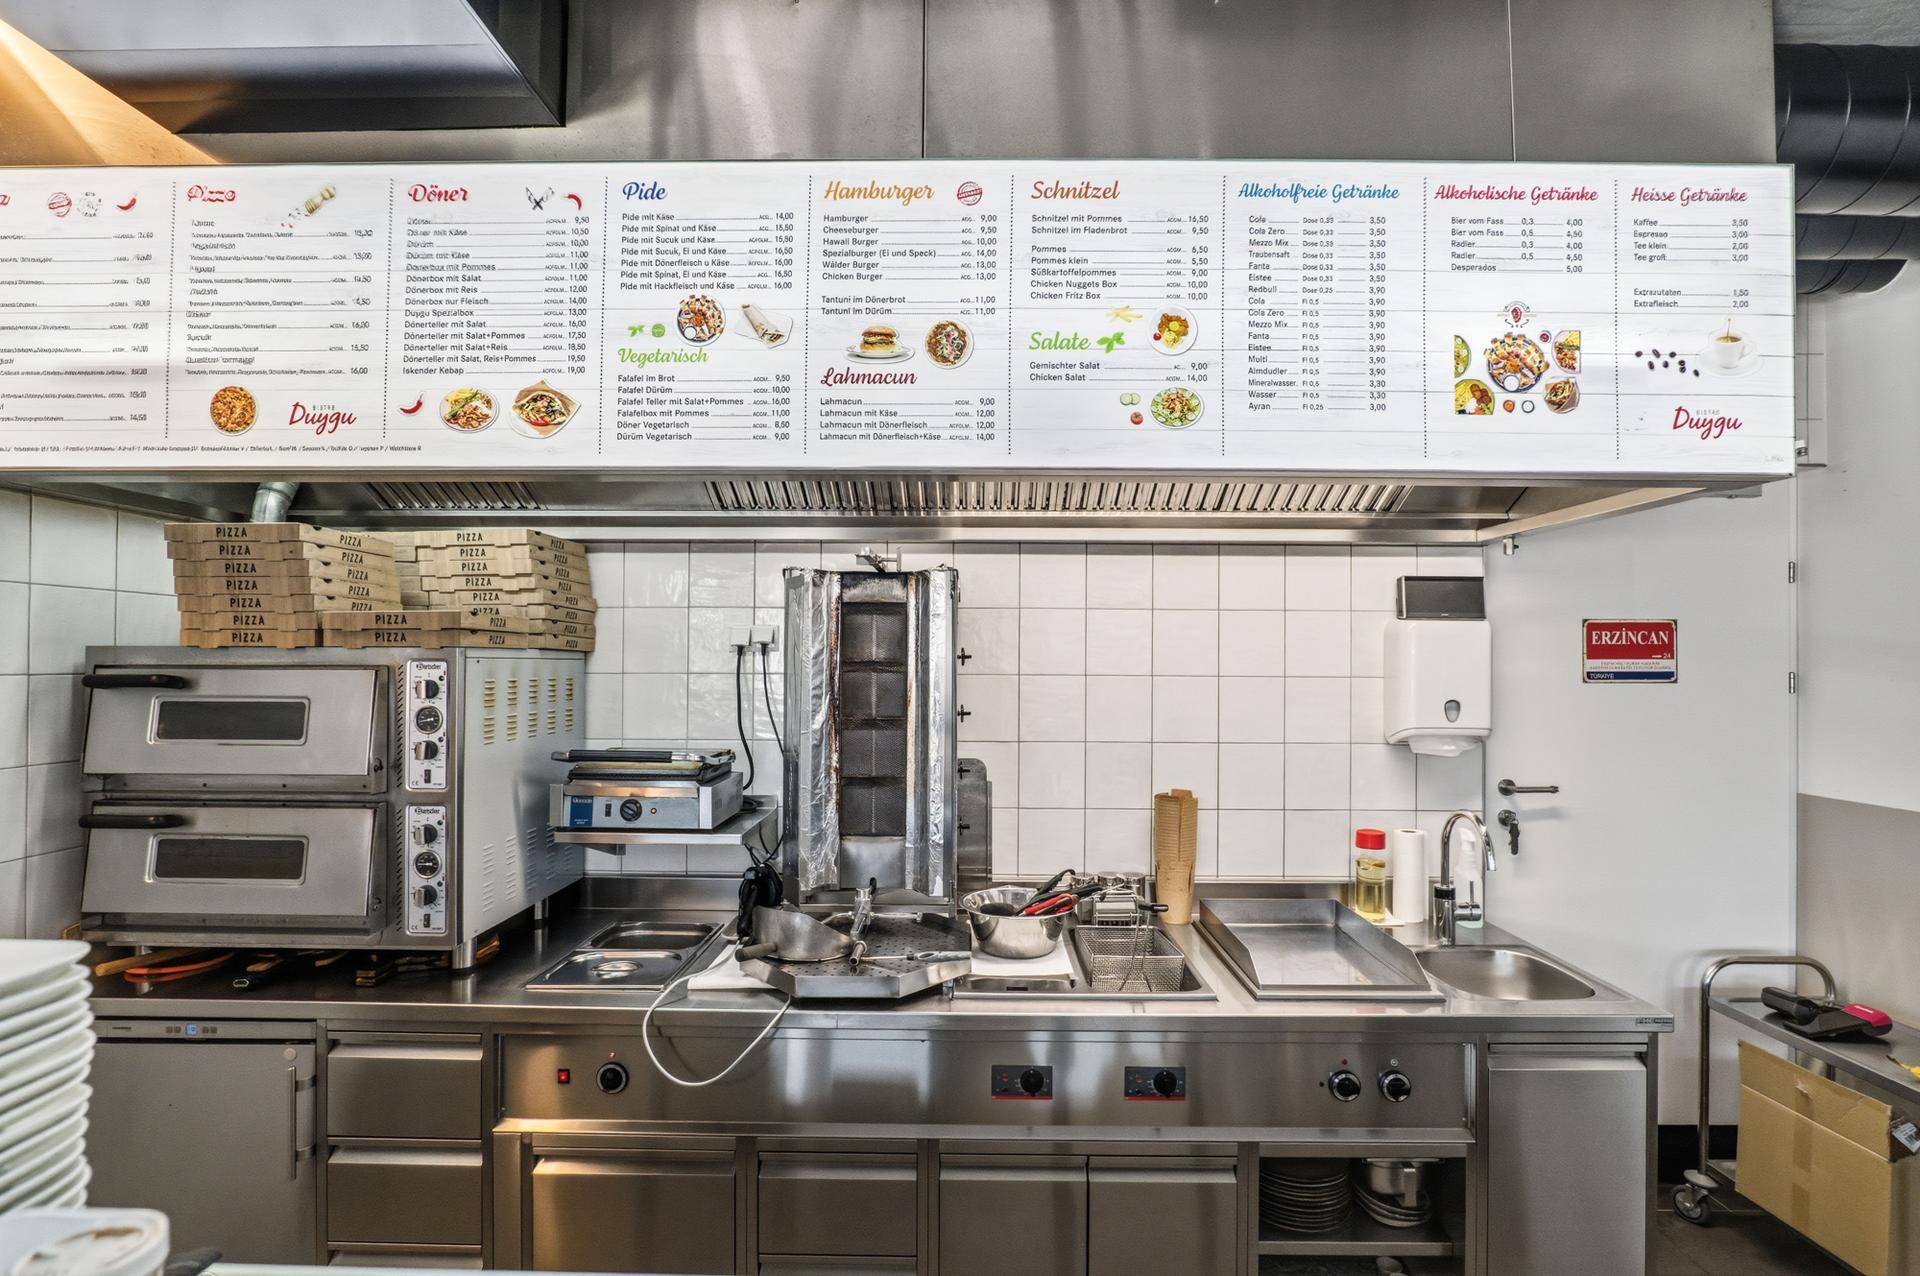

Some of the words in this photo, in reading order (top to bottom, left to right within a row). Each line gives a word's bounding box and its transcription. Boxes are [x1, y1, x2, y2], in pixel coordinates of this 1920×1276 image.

[408, 183, 469, 202] Döner
[622, 181, 667, 200] Pide
[824, 180, 934, 206] Hamburger
[1030, 180, 1120, 200] Schnitzel
[1238, 182, 1328, 203] Alkoholfreie
[1332, 184, 1400, 203] Getränke
[1434, 185, 1527, 200] Alkoholische
[1530, 186, 1598, 205] Getränke
[1631, 187, 1676, 202] Heisse
[1680, 187, 1748, 206] Getränke
[1028, 331, 1091, 351] Salate
[617, 347, 709, 368] Vegetarisch
[820, 367, 917, 387] Lahmacun
[288, 401, 357, 435] Duygu
[1673, 406, 1742, 440] Duygu
[216, 527, 247, 537] PIZZA
[456, 532, 483, 541] PIZZA
[339, 534, 362, 548] PIZZA
[551, 538, 565, 550] PIZZA
[219, 545, 251, 555] PIZZA
[460, 548, 486, 557] PIZZA
[341, 552, 363, 564] PIZZA
[554, 553, 568, 564] PIZZA
[225, 563, 256, 573] PIZZA
[461, 562, 487, 571] PIZZA
[347, 569, 368, 581] PIZZA
[555, 567, 570, 578] PIZZA
[226, 580, 258, 590] PIZZA
[465, 577, 492, 586] PIZZA
[558, 581, 572, 591] PIZZA
[348, 585, 370, 597] PIZZA
[473, 592, 500, 601] PIZZA
[565, 596, 578, 606] PIZZA
[230, 598, 261, 608] PIZZA
[351, 602, 372, 611] PIZZA
[233, 615, 265, 625] PIZZA
[375, 615, 407, 624] PIZZA
[565, 610, 577, 620] PIZZA
[490, 617, 506, 627] PIZZA
[563, 625, 577, 633] PIZZA
[231, 632, 263, 642] PIZZA
[375, 632, 407, 642] PIZZA
[488, 635, 505, 645] PIZZA
[1591, 627, 1669, 645] ERZİNCAN
[565, 639, 578, 648] PIZZA
